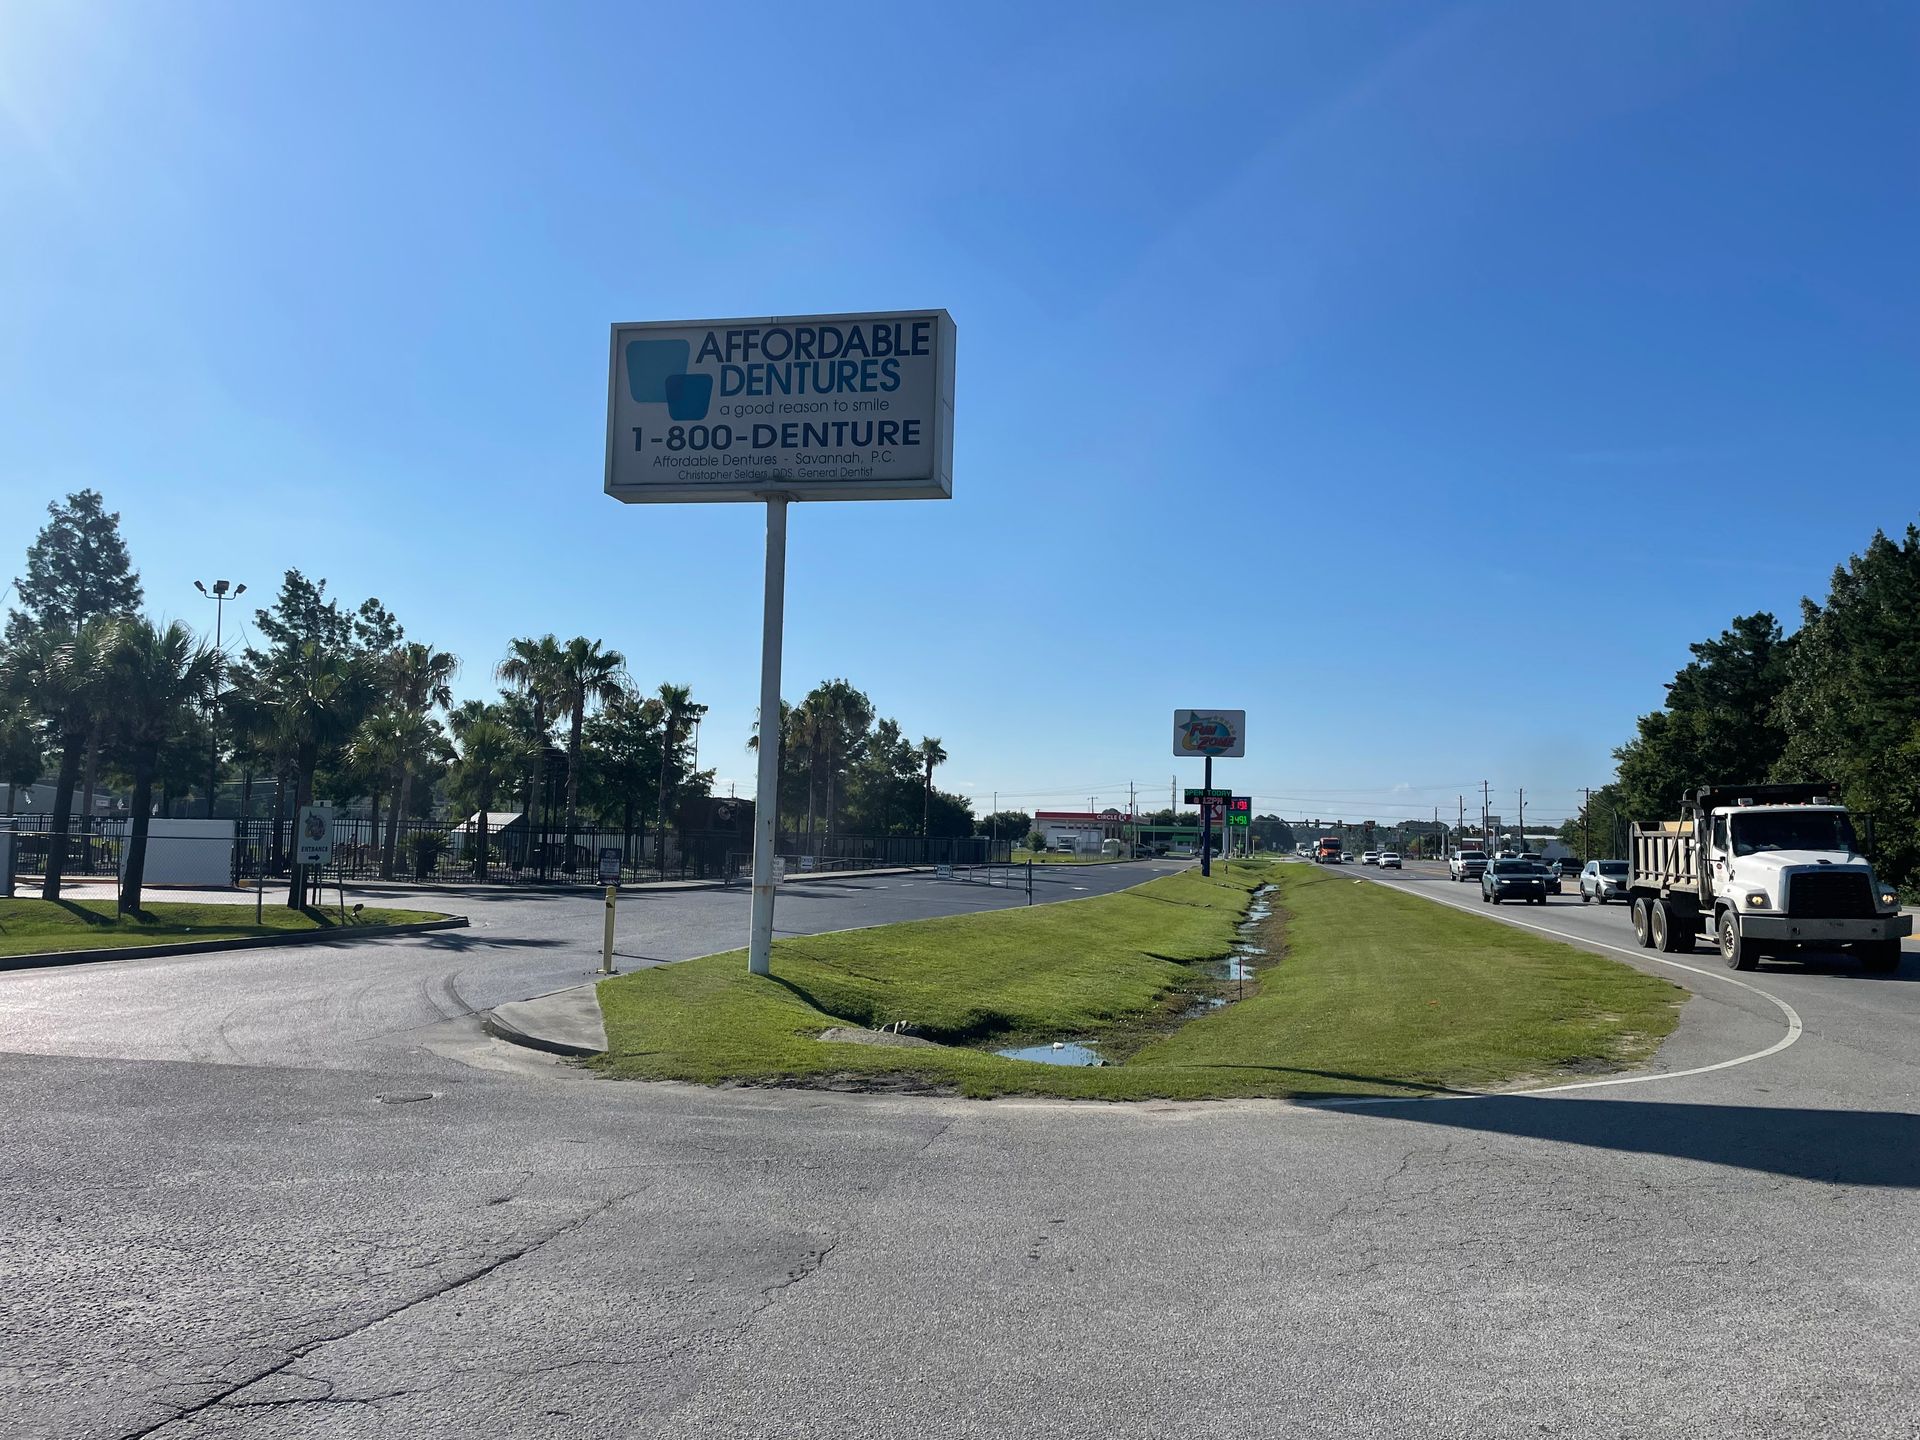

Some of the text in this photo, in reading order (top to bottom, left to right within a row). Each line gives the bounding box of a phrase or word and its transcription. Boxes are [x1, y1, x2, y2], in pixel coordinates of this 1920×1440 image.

[695, 322, 931, 364] AFFORDABLE
[720, 358, 901, 397] DENTURES
[720, 398, 890, 418] a good reason to smile
[632, 419, 921, 452] 1-800-DENTURE
[653, 455, 719, 468] Affordable
[722, 453, 777, 466] Dentures
[795, 451, 864, 466] Savannah,
[871, 450, 896, 463] P.C.
[678, 470, 732, 481] Christopher
[797, 467, 838, 478] General
[840, 466, 873, 477] Dentist
